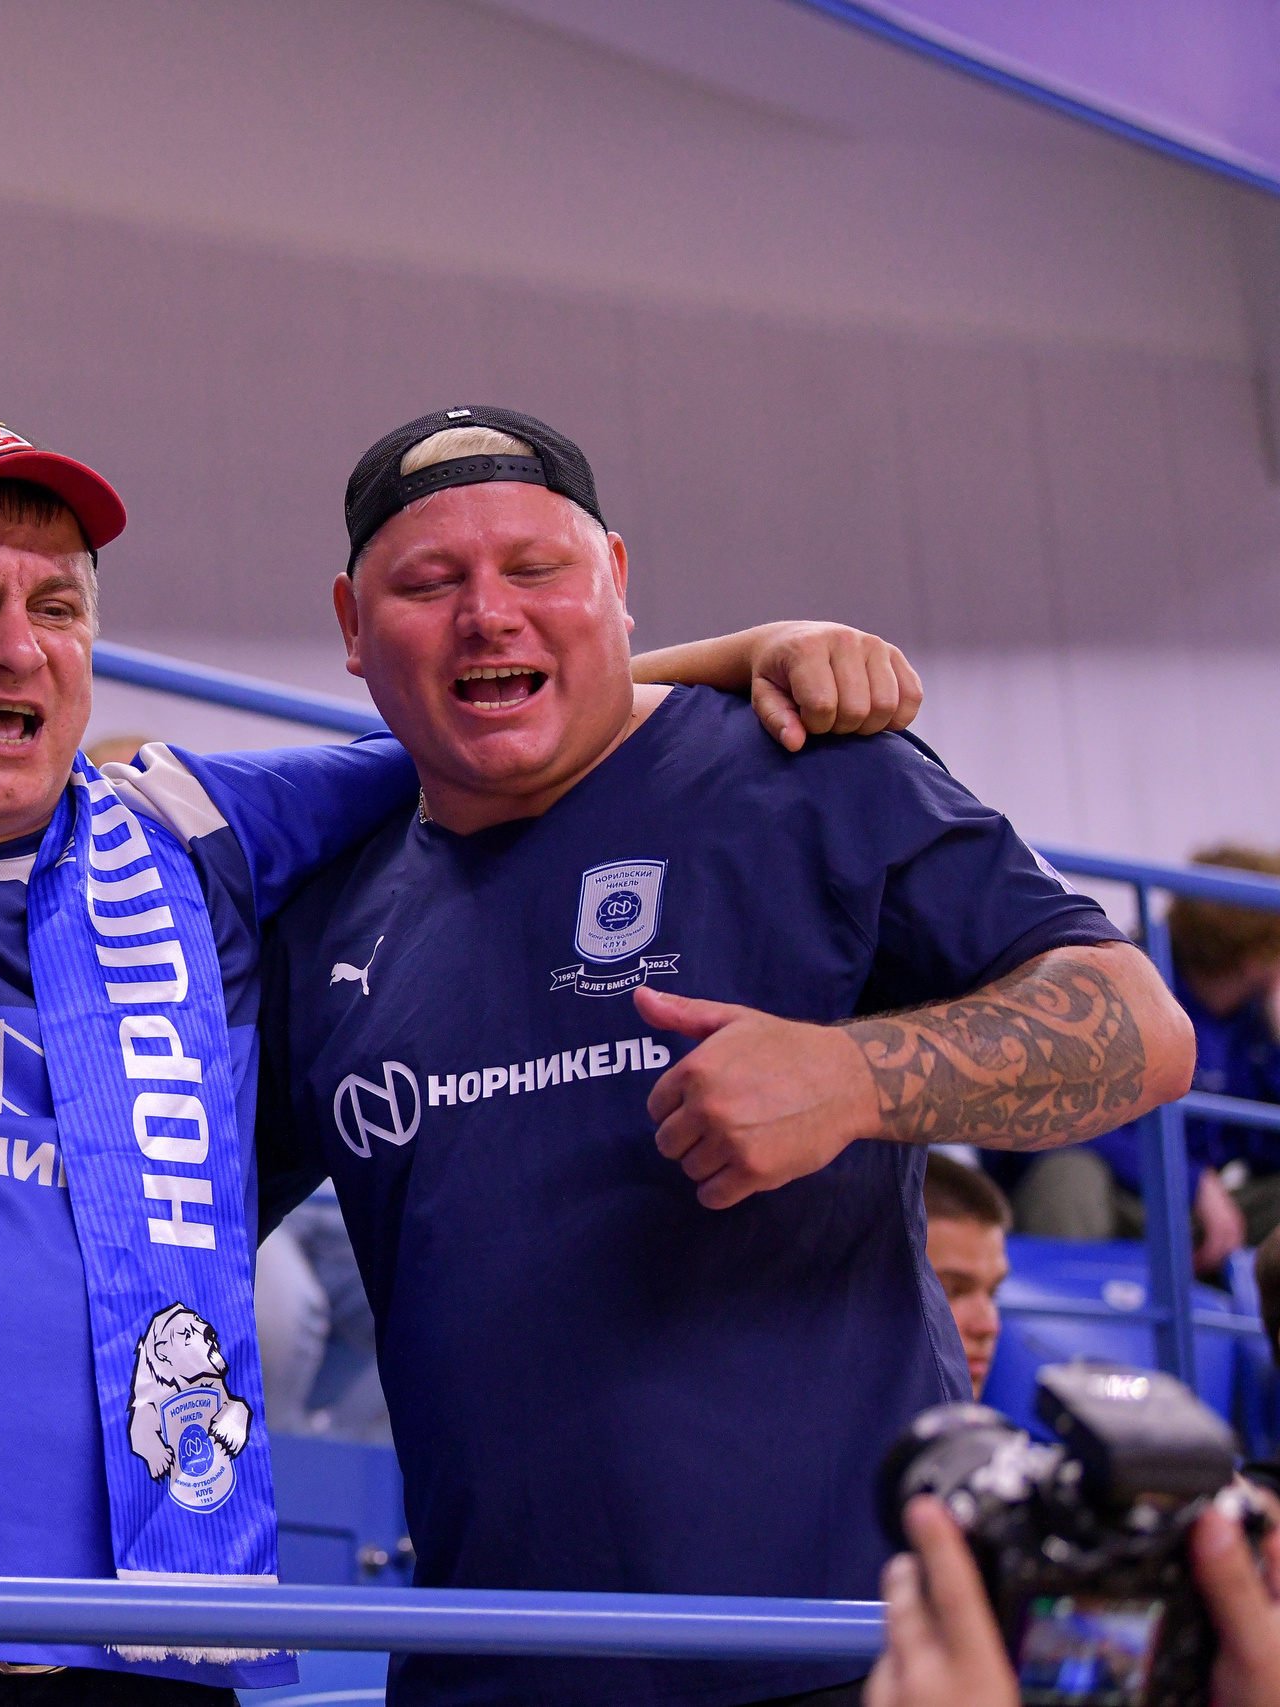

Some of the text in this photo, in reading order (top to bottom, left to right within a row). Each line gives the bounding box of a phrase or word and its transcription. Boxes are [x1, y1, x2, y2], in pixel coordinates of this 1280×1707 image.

[594, 870, 653, 884] НОРИЛЬСКИЙ
[606, 880, 639, 889] НИКЕЛЬ
[602, 940, 627, 949] КЛУБ
[648, 960, 669, 969] 2023
[558, 972, 576, 982] 1993
[579, 974, 641, 991] 30 ЛЕТ ВМЕСТЕ
[427, 1036, 671, 1107] НОРНИКЕЛЬ
[170, 1399, 211, 1417] НОРИЛЬСКИЙ
[180, 1411, 203, 1424] НИКЕЛЬ
[175, 1465, 226, 1488] МИНИ-ФУТБОЛЬНЫЙ
[195, 1487, 214, 1498] КЛУБ
